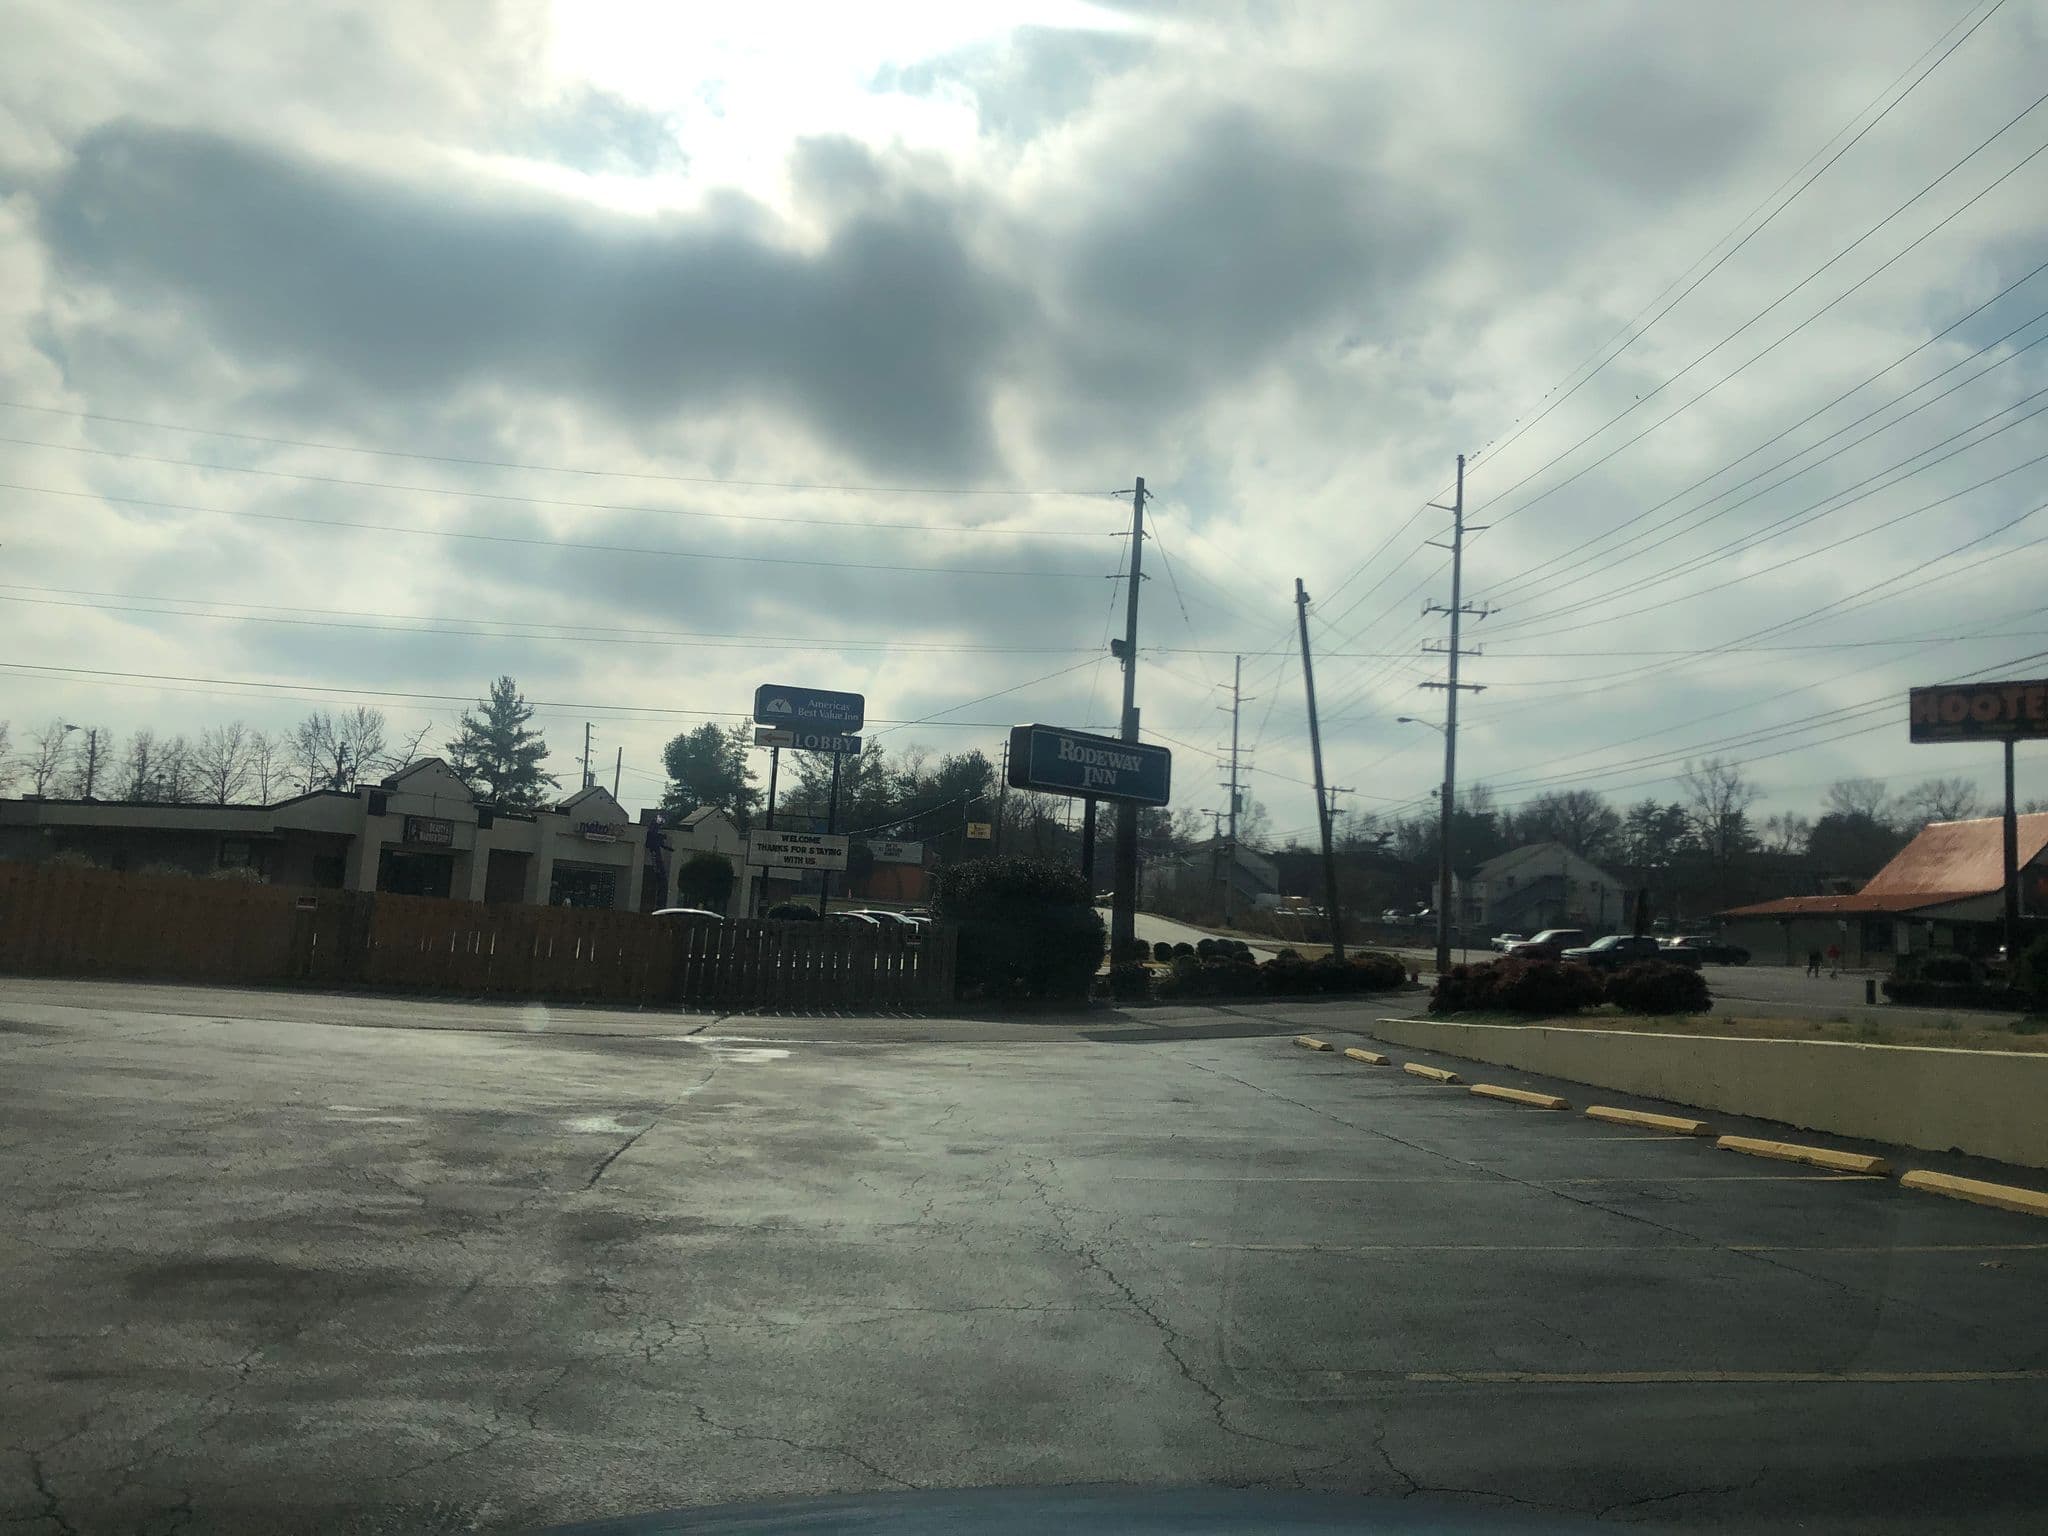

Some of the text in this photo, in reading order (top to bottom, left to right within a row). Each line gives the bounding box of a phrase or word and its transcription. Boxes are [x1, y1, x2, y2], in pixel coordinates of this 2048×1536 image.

[798, 707, 859, 721] Best Value Inn
[795, 734, 854, 751] LOBBY
[1058, 738, 1143, 772] RODEWAY
[1082, 766, 1118, 787] INN
[781, 835, 821, 844] WELCOME
[757, 843, 788, 853] THANKS
[791, 846, 807, 854] FOR
[784, 856, 816, 865] WITH US
